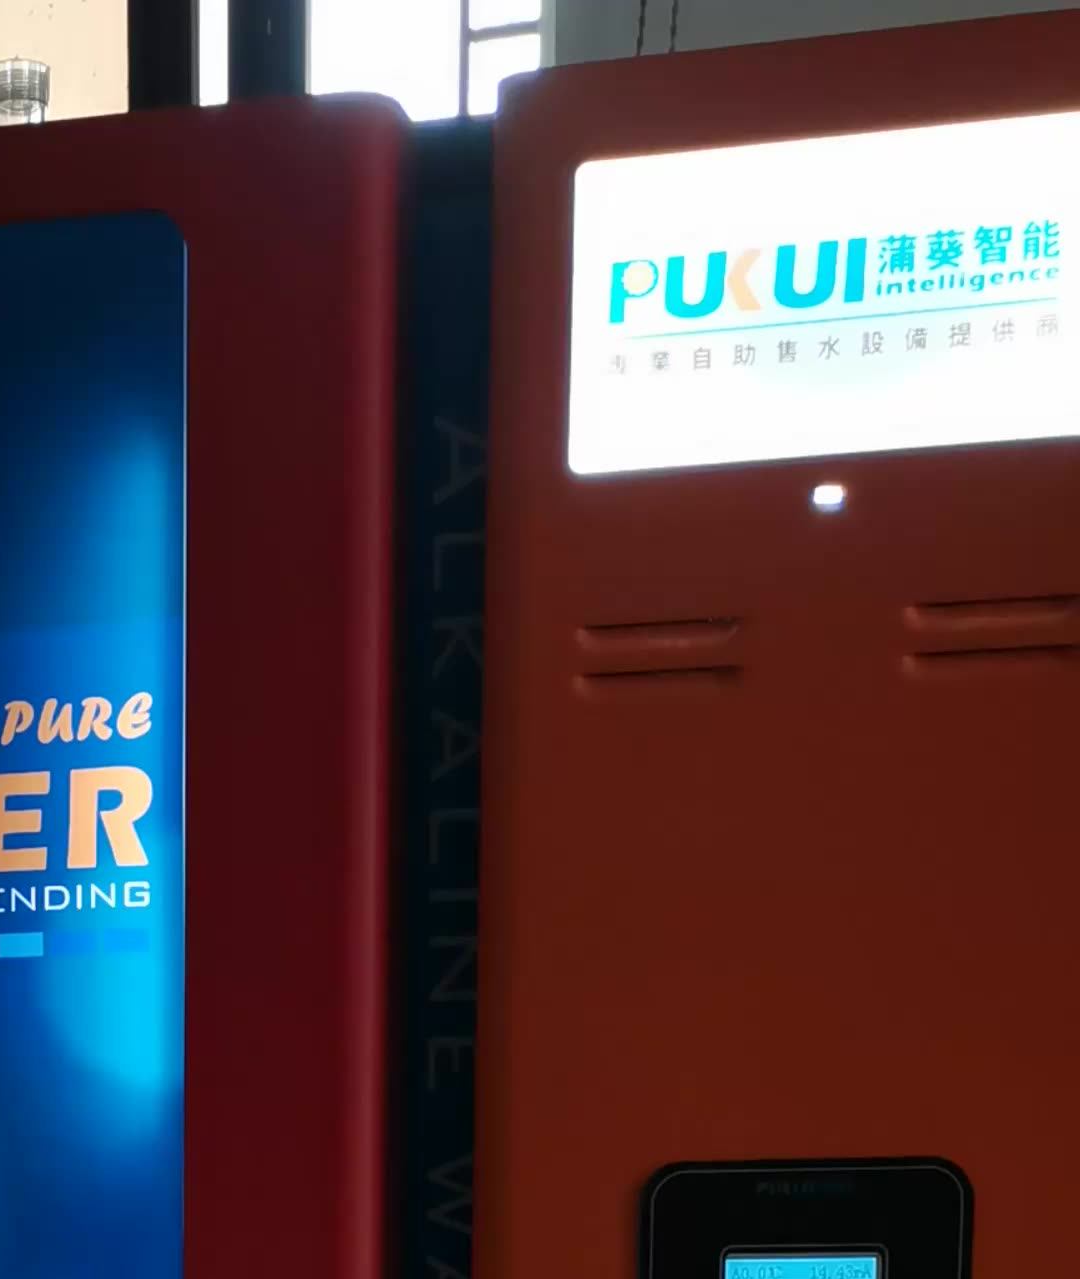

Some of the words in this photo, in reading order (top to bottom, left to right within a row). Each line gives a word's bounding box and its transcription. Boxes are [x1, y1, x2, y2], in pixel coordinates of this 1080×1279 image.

[877, 219, 1060, 274] 蒲葵智能
[609, 237, 867, 324] PUKUI
[876, 266, 1060, 296] intelligence
[2, 691, 153, 746] PURE
[425, 415, 486, 1093] ALKALINE
